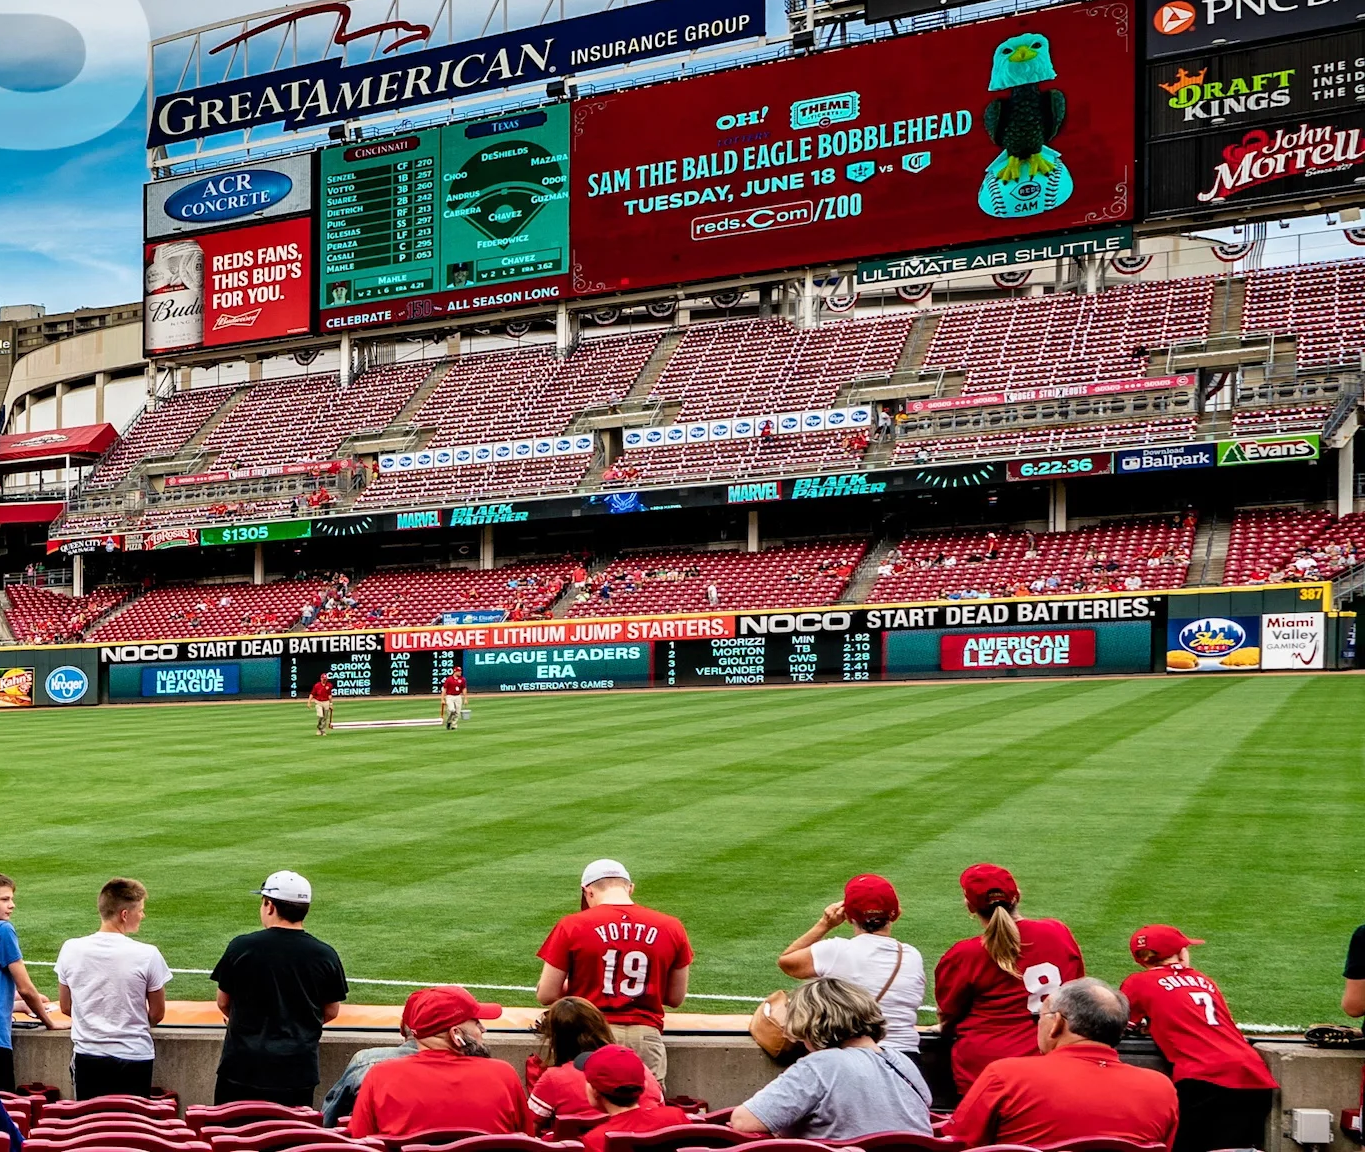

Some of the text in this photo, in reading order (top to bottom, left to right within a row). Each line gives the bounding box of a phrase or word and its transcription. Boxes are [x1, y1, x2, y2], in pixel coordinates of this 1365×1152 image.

[571, 14, 750, 65] INSURANCE GROUP
[1313, 62, 1341, 74] THE
[1169, 69, 1295, 108] DRAFT
[1313, 89, 1345, 100] THE
[800, 100, 850, 117] THEME
[1183, 89, 1290, 122] KINGS
[1263, 124, 1333, 154] John
[531, 153, 568, 166] MAZARA
[587, 109, 973, 198] SAM THE BALD EAGLE BOBBLEHEAD
[327, 173, 356, 184] SENZEL
[443, 172, 468, 182] CHOO
[542, 175, 567, 185] ODOR
[740, 168, 836, 197] JUNE 18
[202, 173, 252, 197] ACR
[327, 185, 355, 195] VOTTO
[327, 195, 357, 206] SUAREZ
[446, 190, 480, 202] ANDRUS
[181, 190, 270, 218] CONCRETE
[1015, 201, 1037, 212] SAM
[327, 206, 363, 217] DIETRICH
[444, 206, 481, 219] CABRERA
[327, 220, 346, 229] PUIG
[327, 229, 361, 239] IGLESIAS
[327, 241, 358, 251] PERAZA
[213, 250, 254, 272] REDS
[327, 252, 354, 262] CASALI
[862, 237, 1120, 283] ULTIMATE AIR SHUTTLE
[327, 263, 354, 273] MAHLE
[212, 272, 248, 291] THIS
[213, 290, 243, 310] FOR
[326, 286, 559, 328] CELEBRATE ALL SEASON LONG
[1143, 447, 1184, 456] Download
[1245, 443, 1310, 457] Evans
[1142, 452, 1210, 468] Ballpark
[1020, 459, 1093, 477] 6:22:36
[794, 473, 868, 489] BLACK
[728, 482, 782, 504] MARVEL
[791, 482, 887, 499] PANTHER
[397, 511, 441, 530] MARVEL
[222, 526, 269, 541] $1305
[60, 541, 82, 554] QUEEN
[1300, 588, 1322, 600] 387
[739, 599, 1155, 634] NOCO START DEAD BATTERIES.
[1267, 616, 1314, 628] Miami
[493, 623, 622, 645] LITHIUM JUMP
[1189, 632, 1236, 647] Skyline
[1273, 629, 1318, 643] Valley
[711, 636, 814, 647] ODORIZZI MIN
[963, 635, 1069, 651] AMERICAN
[101, 638, 284, 662] NOCO START DEAD
[475, 647, 640, 665] LEAGUE LEADERS
[713, 645, 811, 657] MORTON TB
[963, 647, 1069, 667] LEAGUE
[351, 654, 371, 662] RYU
[718, 652, 870, 665] GIOLITO CWS 2.28
[330, 661, 410, 671] SOROKA ATL
[391, 669, 408, 677] CIN
[537, 665, 575, 678] ERA
[696, 664, 816, 676] VERLANDER HOU
[156, 668, 224, 681] NATIONAL
[725, 673, 814, 684] MINOR TEX
[156, 678, 224, 694] LEAGUE
[337, 679, 371, 688] DAVIES
[580, 680, 613, 689] GAMES
[594, 921, 658, 946] VOTTO
[601, 949, 649, 998] 19
[1023, 962, 1062, 1015] 8
[1189, 992, 1219, 1026] 7
